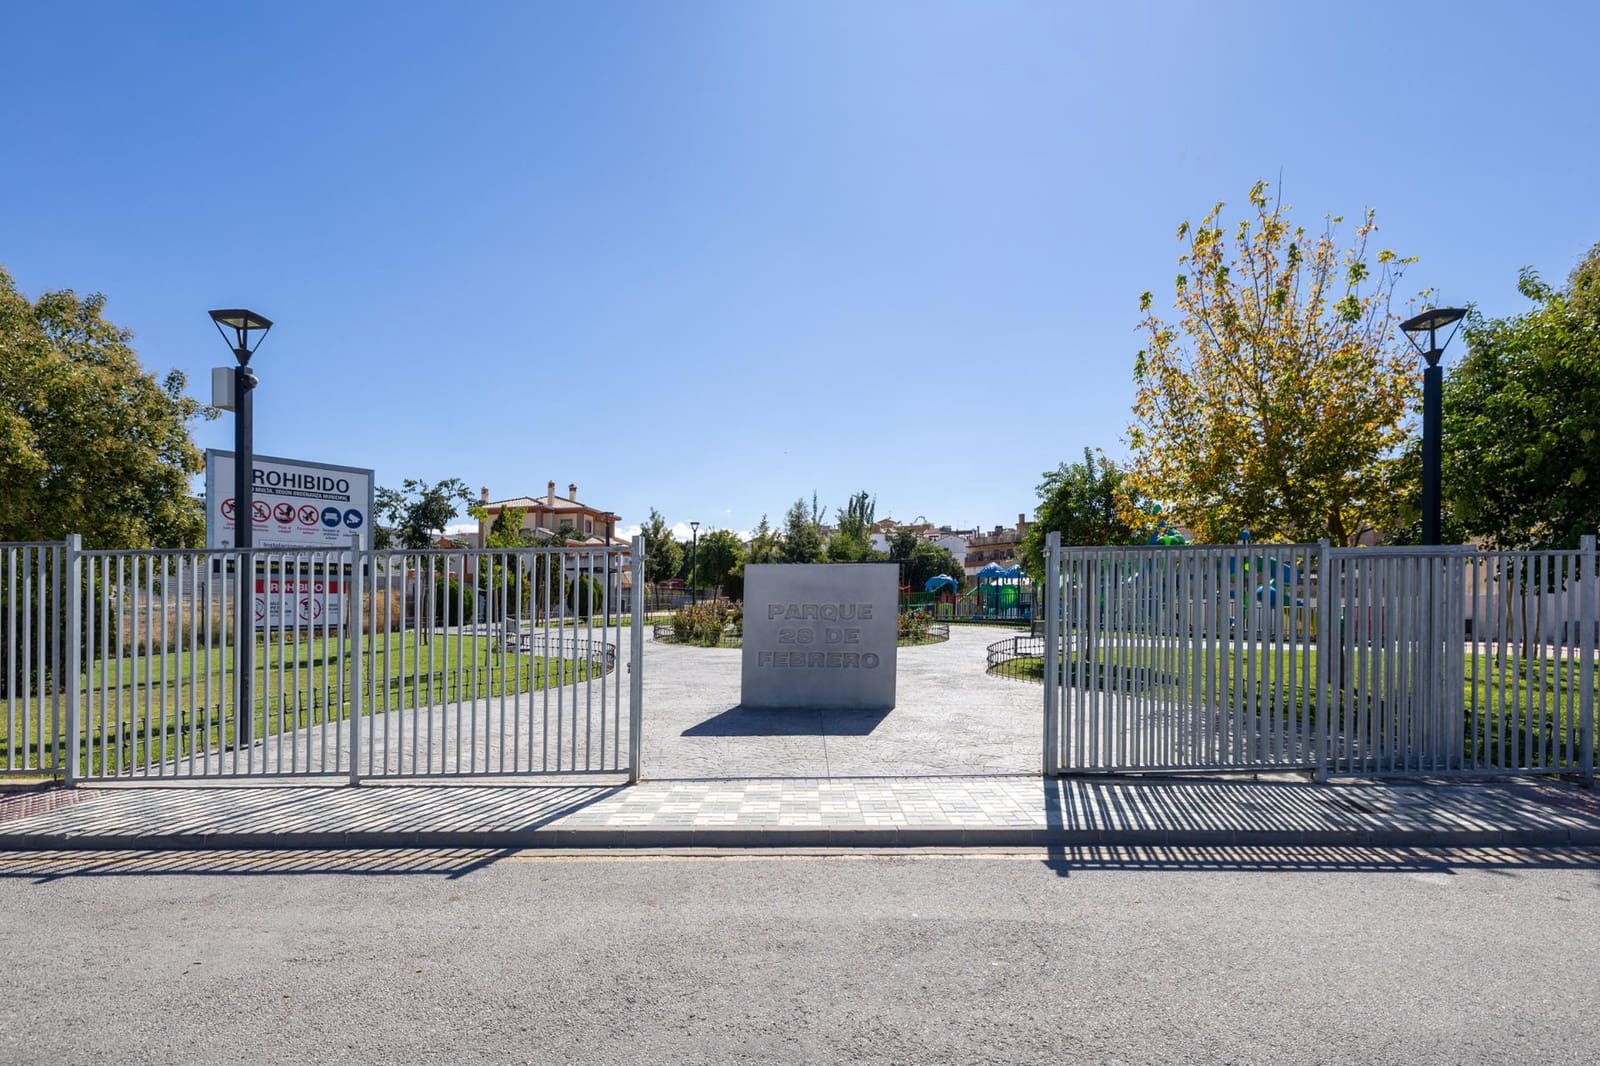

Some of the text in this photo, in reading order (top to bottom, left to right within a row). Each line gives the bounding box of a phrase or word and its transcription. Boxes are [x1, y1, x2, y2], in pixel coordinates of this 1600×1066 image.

[252, 469, 350, 494] ROHIBIDO
[767, 603, 873, 622] PARQUE
[778, 628, 860, 644] 28 DE
[758, 651, 880, 669] FEBRERO
